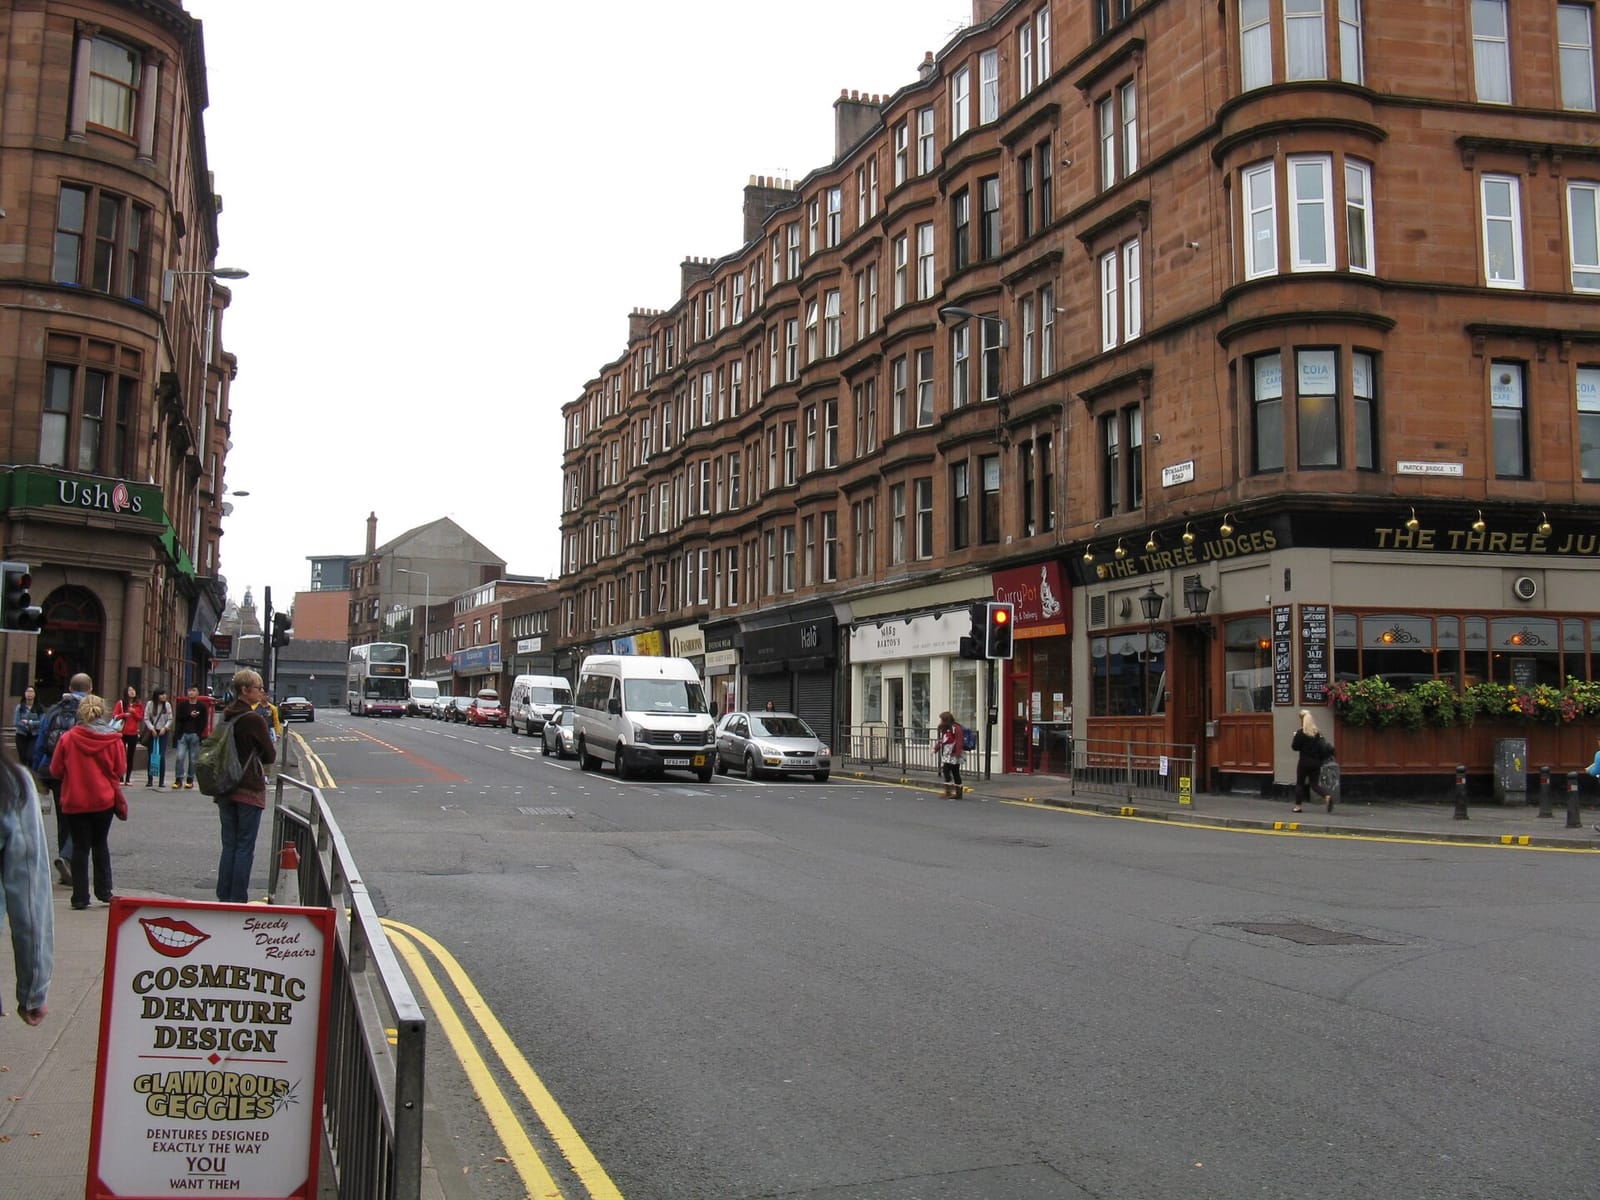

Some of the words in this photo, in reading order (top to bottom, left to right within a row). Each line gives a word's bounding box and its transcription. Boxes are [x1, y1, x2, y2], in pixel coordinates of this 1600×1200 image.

[1374, 527, 1437, 550] THE
[1447, 530, 1549, 553] THREE
[1557, 533, 1600, 554] JU
[1106, 558, 1138, 578] THE
[1140, 544, 1197, 572] THREE
[1202, 529, 1278, 561] JUDGES
[243, 918, 289, 932] Speedy
[255, 933, 301, 946] Dental
[265, 946, 317, 960] Repairs
[132, 964, 307, 1002] COSMETIC
[141, 996, 293, 1025] DENTURE
[153, 1026, 278, 1053] DESIGN
[134, 1071, 290, 1098] GLAMOROUS
[146, 1093, 275, 1121] GEGGIES
[146, 1128, 208, 1141] DENTURES
[211, 1130, 270, 1142] DESIGNED
[152, 1142, 205, 1154] EXACTLY
[208, 1143, 231, 1154] THE
[235, 1143, 262, 1155] WAY
[185, 1156, 226, 1173] YOU
[169, 1179, 205, 1190] WANT
[208, 1179, 240, 1191] THEM
